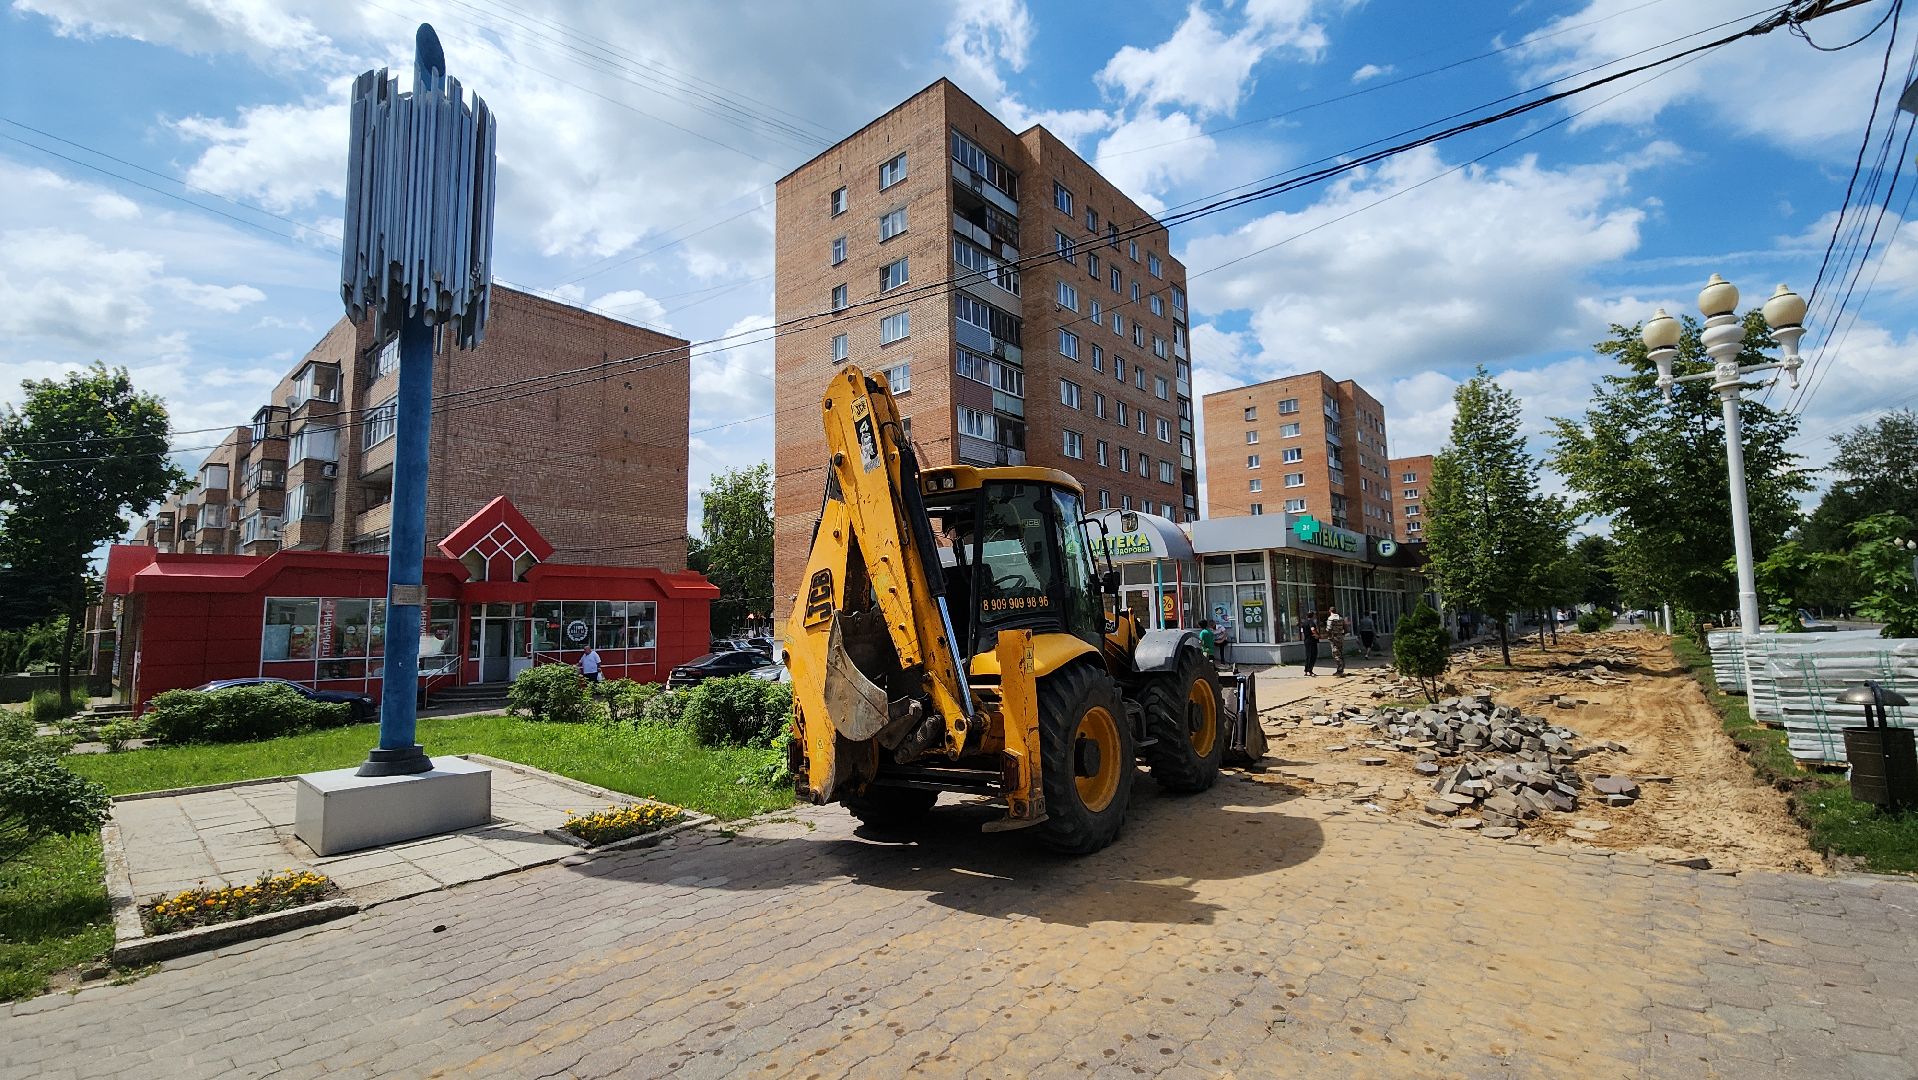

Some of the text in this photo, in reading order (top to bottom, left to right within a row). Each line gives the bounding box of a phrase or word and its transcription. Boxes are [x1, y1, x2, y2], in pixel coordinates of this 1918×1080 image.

[1025, 519, 1040, 527] JCB
[1116, 545, 1150, 556] ЗДОРОВЬЯ
[808, 570, 833, 621] JCB
[983, 595, 1049, 611] 8 909 909 98 96
[321, 610, 333, 657] ПЕЛЬМЕНИ
